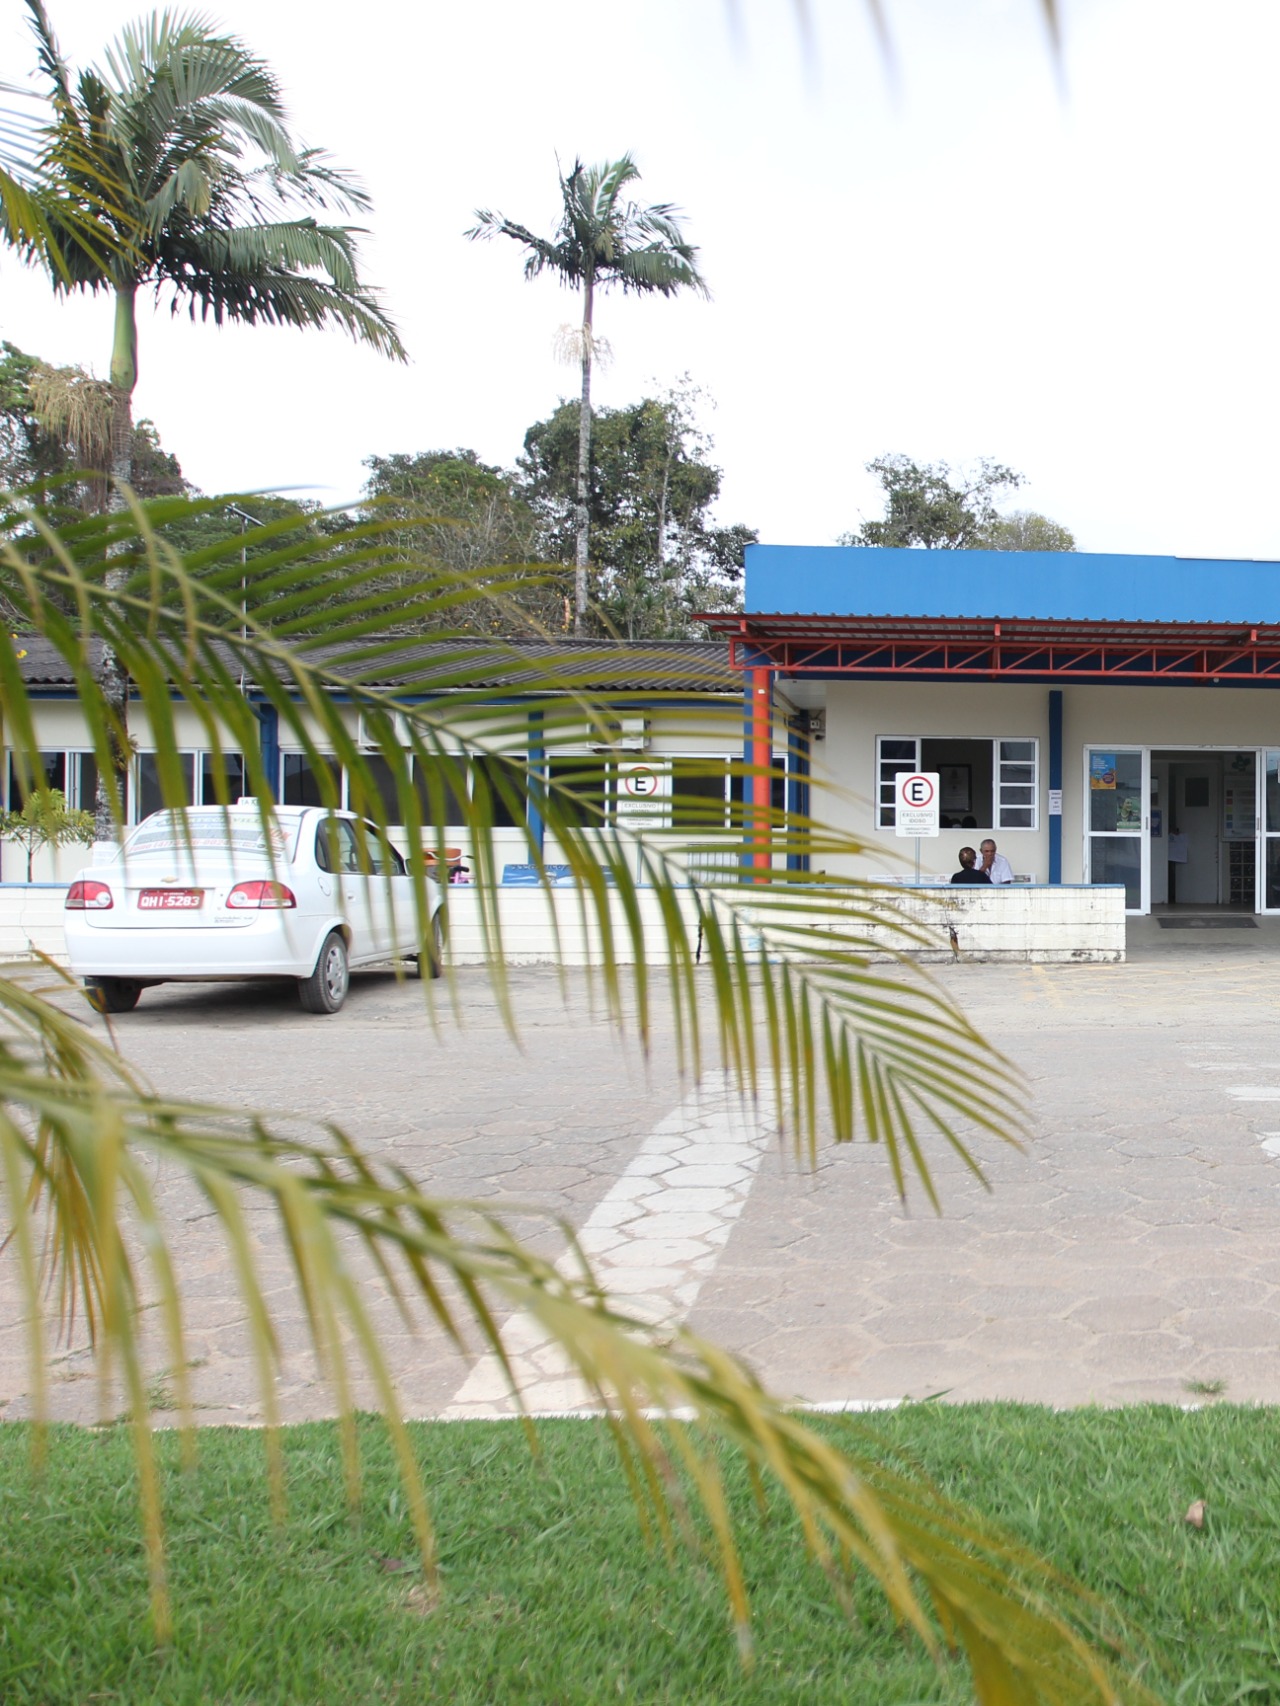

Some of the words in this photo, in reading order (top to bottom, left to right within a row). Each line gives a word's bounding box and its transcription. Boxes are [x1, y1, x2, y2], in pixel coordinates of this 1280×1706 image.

[635, 774, 647, 792] E
[912, 783, 924, 801] E
[141, 896, 200, 907] QHI-5283
